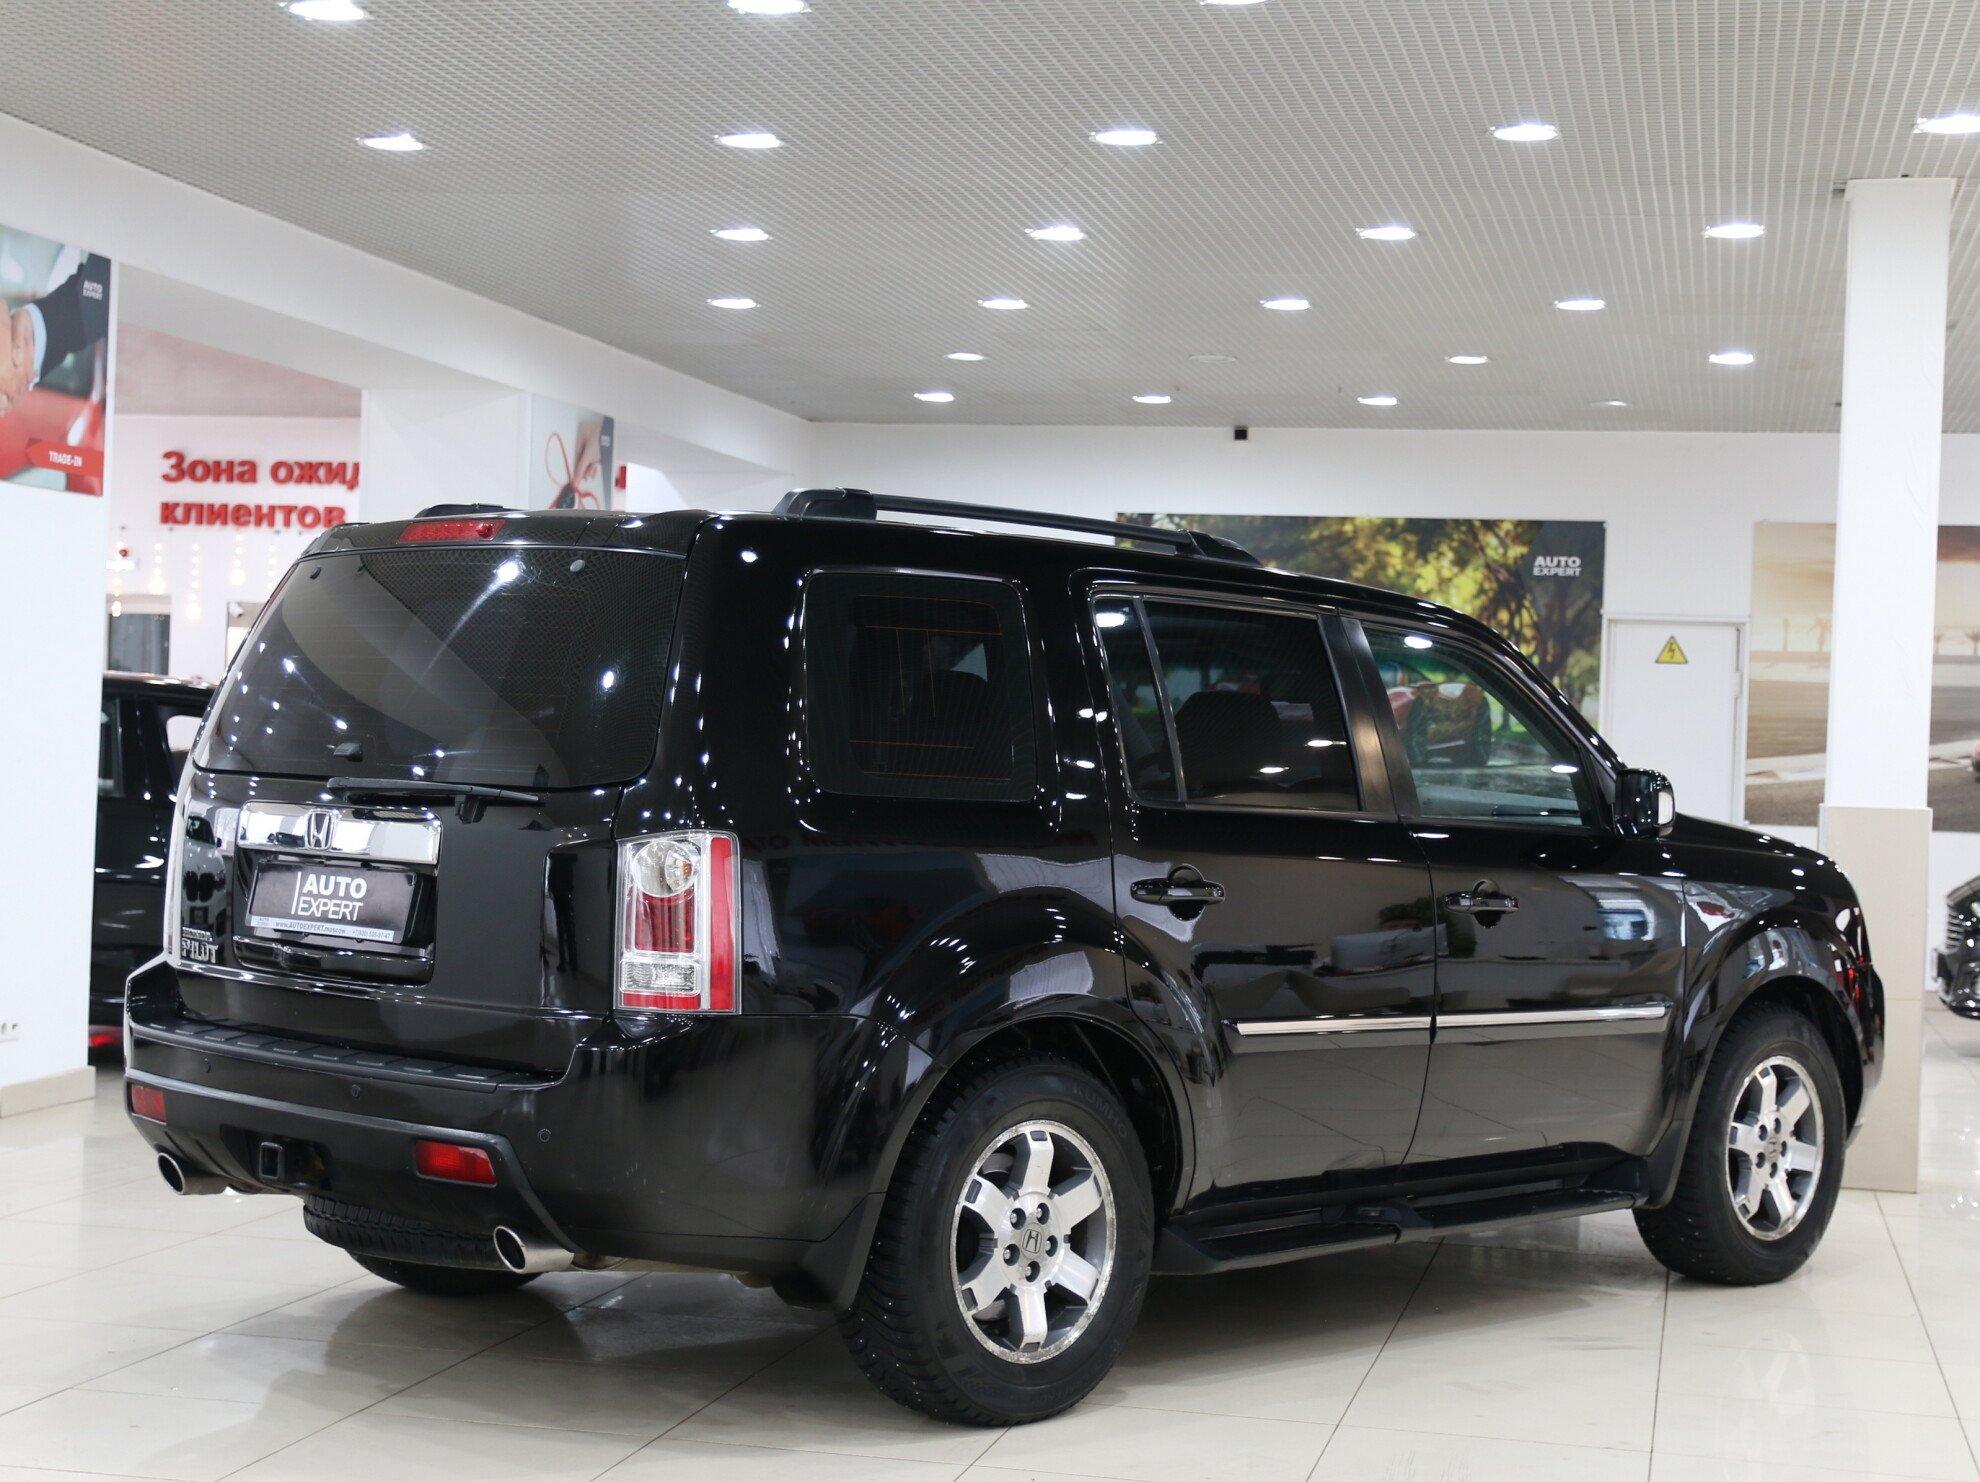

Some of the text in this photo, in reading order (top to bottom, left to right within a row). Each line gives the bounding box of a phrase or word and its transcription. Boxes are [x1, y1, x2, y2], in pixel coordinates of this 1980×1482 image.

[49, 450, 83, 467] TRADE-IN
[162, 451, 257, 483] Зона
[161, 502, 346, 529] клиентов
[1533, 567, 1581, 576] EXPERT
[1534, 556, 1582, 567] AUTO
[302, 873, 367, 899] AUTO
[298, 896, 364, 922] EXPERT
[275, 921, 346, 934] www.AUTOEXPERT.moscow
[181, 937, 219, 964] PILOT
